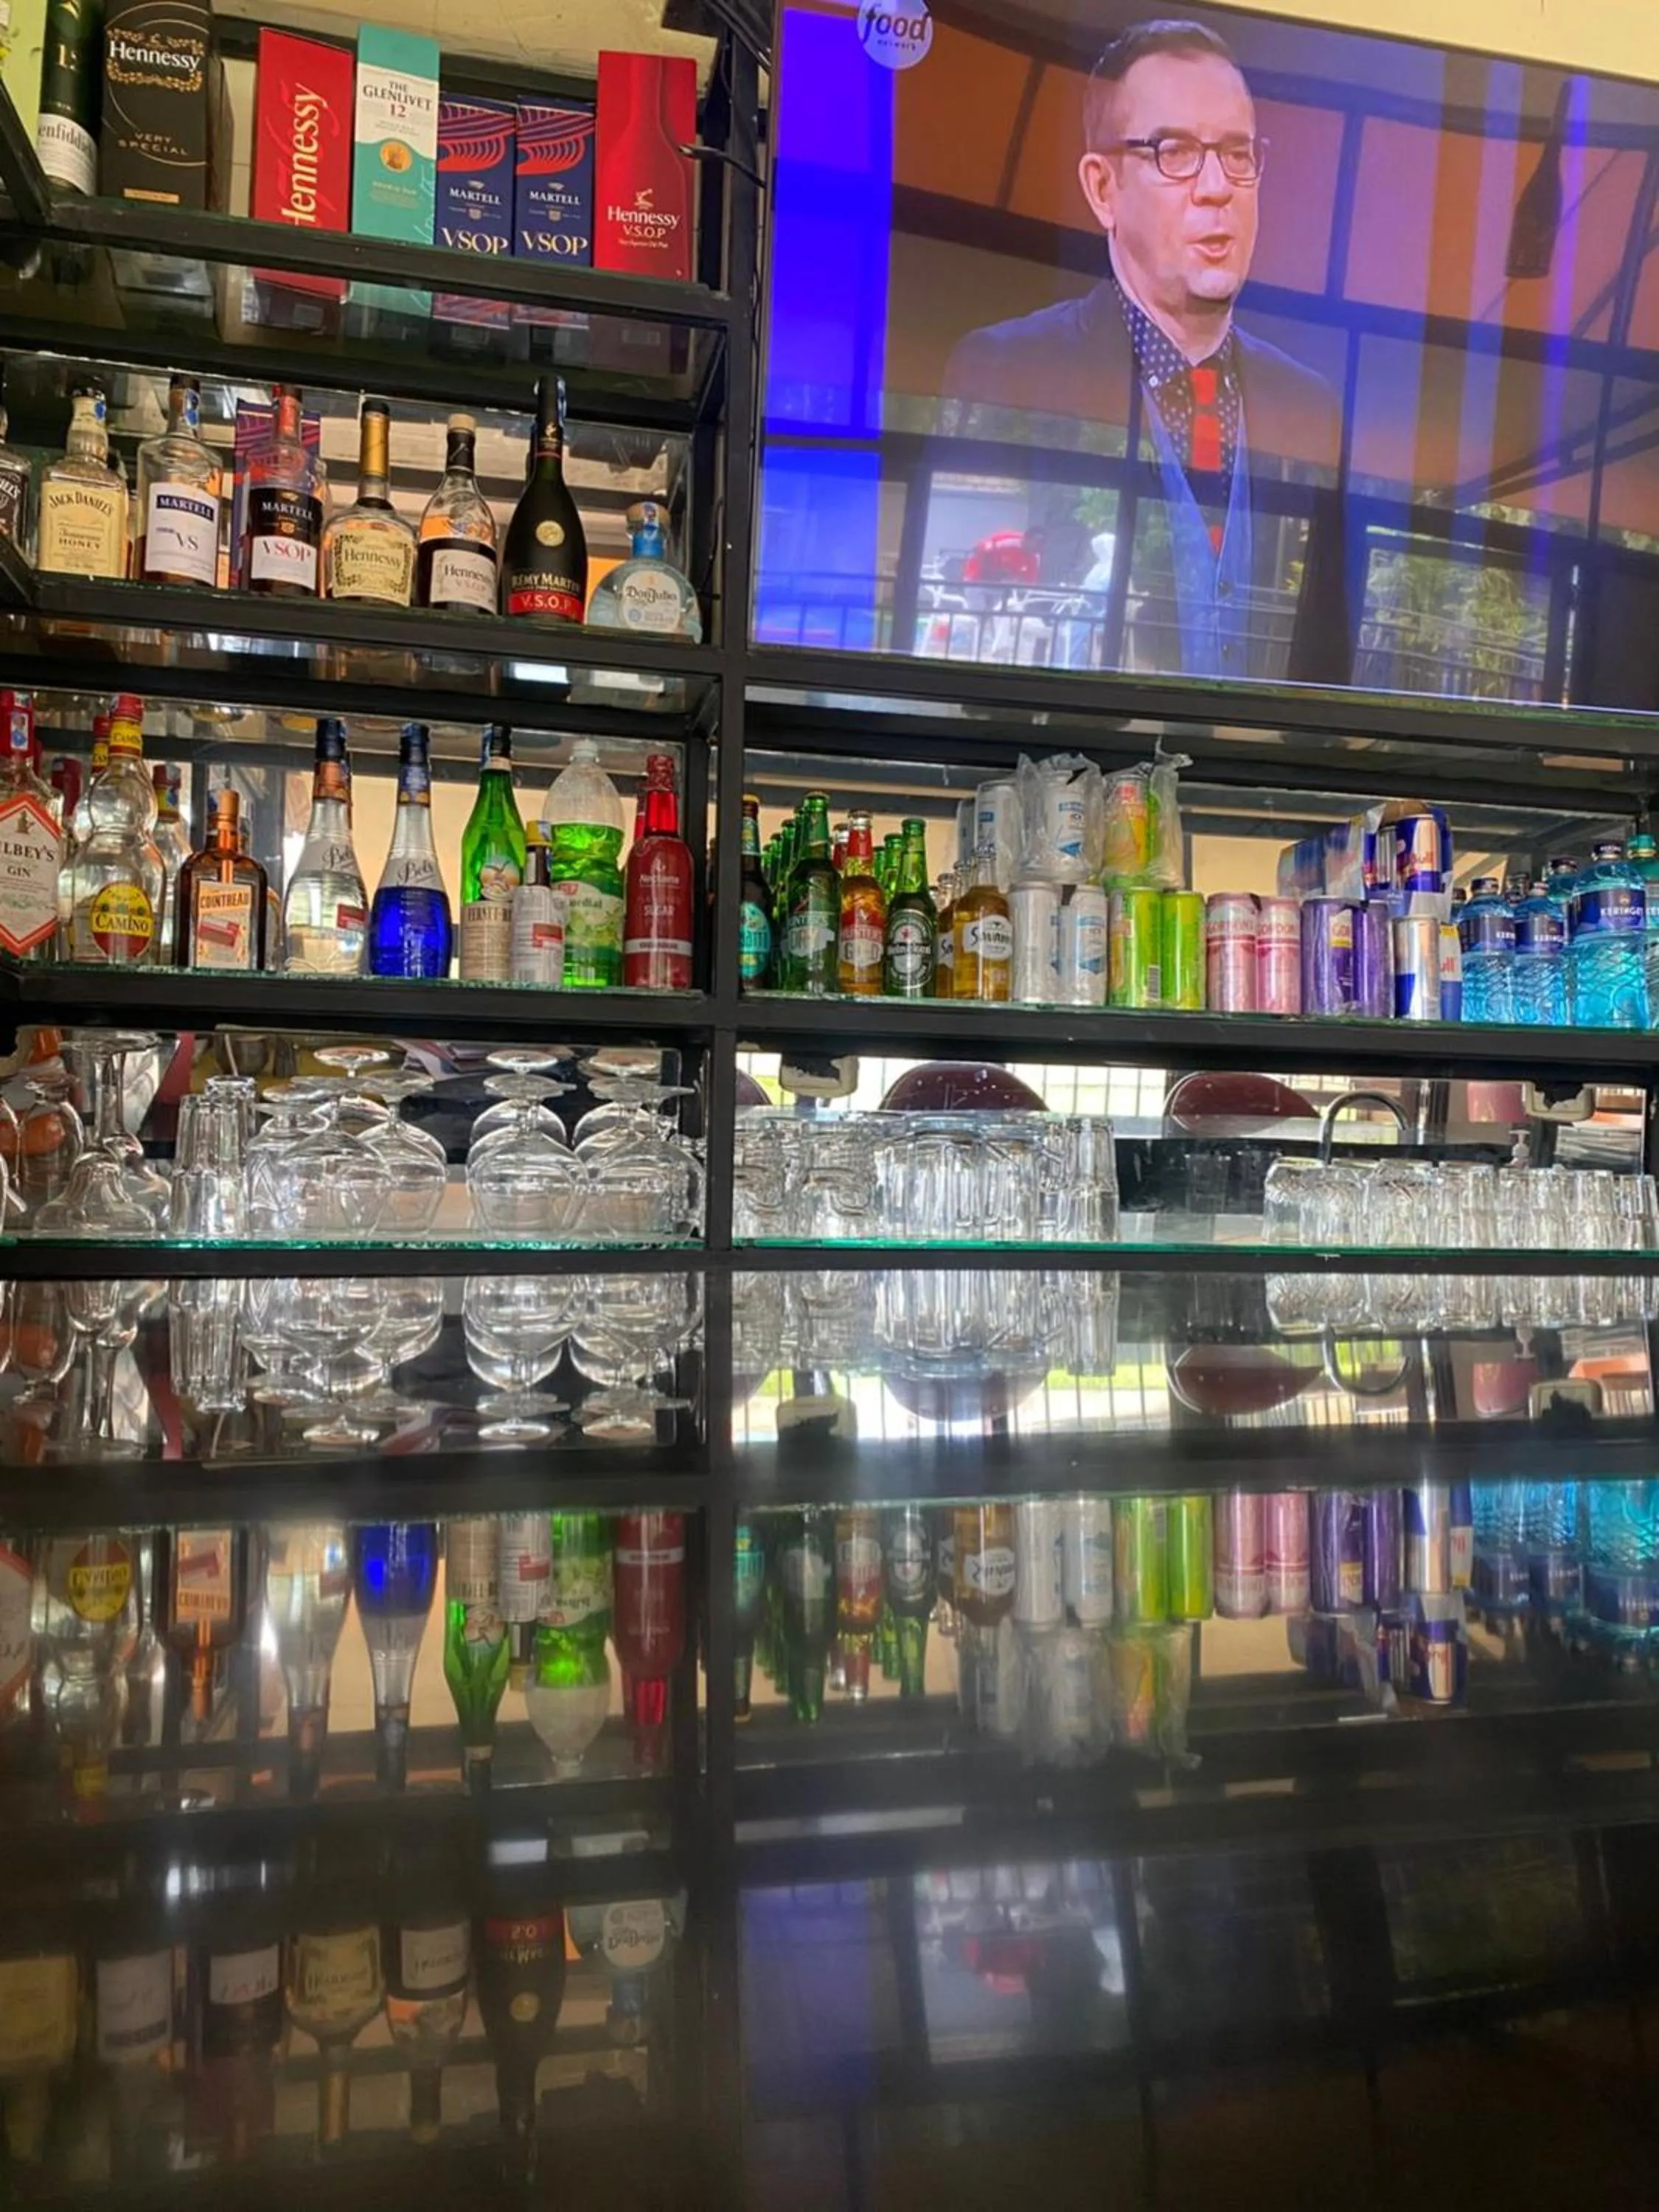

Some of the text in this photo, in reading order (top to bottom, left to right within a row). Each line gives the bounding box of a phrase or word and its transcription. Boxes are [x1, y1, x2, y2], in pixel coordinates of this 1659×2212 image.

[863, 3, 931, 43] food
[110, 40, 200, 72] Hennessy
[389, 80, 407, 92] THE
[363, 85, 432, 111] GLENLIVET
[389, 104, 406, 117] 12
[118, 139, 188, 156] SPECIAL
[134, 131, 172, 144] VERY
[449, 187, 501, 205] MARTELL
[529, 190, 581, 206] MARTELL
[607, 205, 680, 229] Hennessy
[441, 226, 509, 254] VSOP
[520, 230, 588, 256] VSOP
[159, 496, 211, 518] MARTELL
[261, 501, 313, 521] MARTELL
[262, 540, 311, 562] VSOP
[344, 548, 401, 569] Hennessy
[7, 865, 32, 877] GIN
